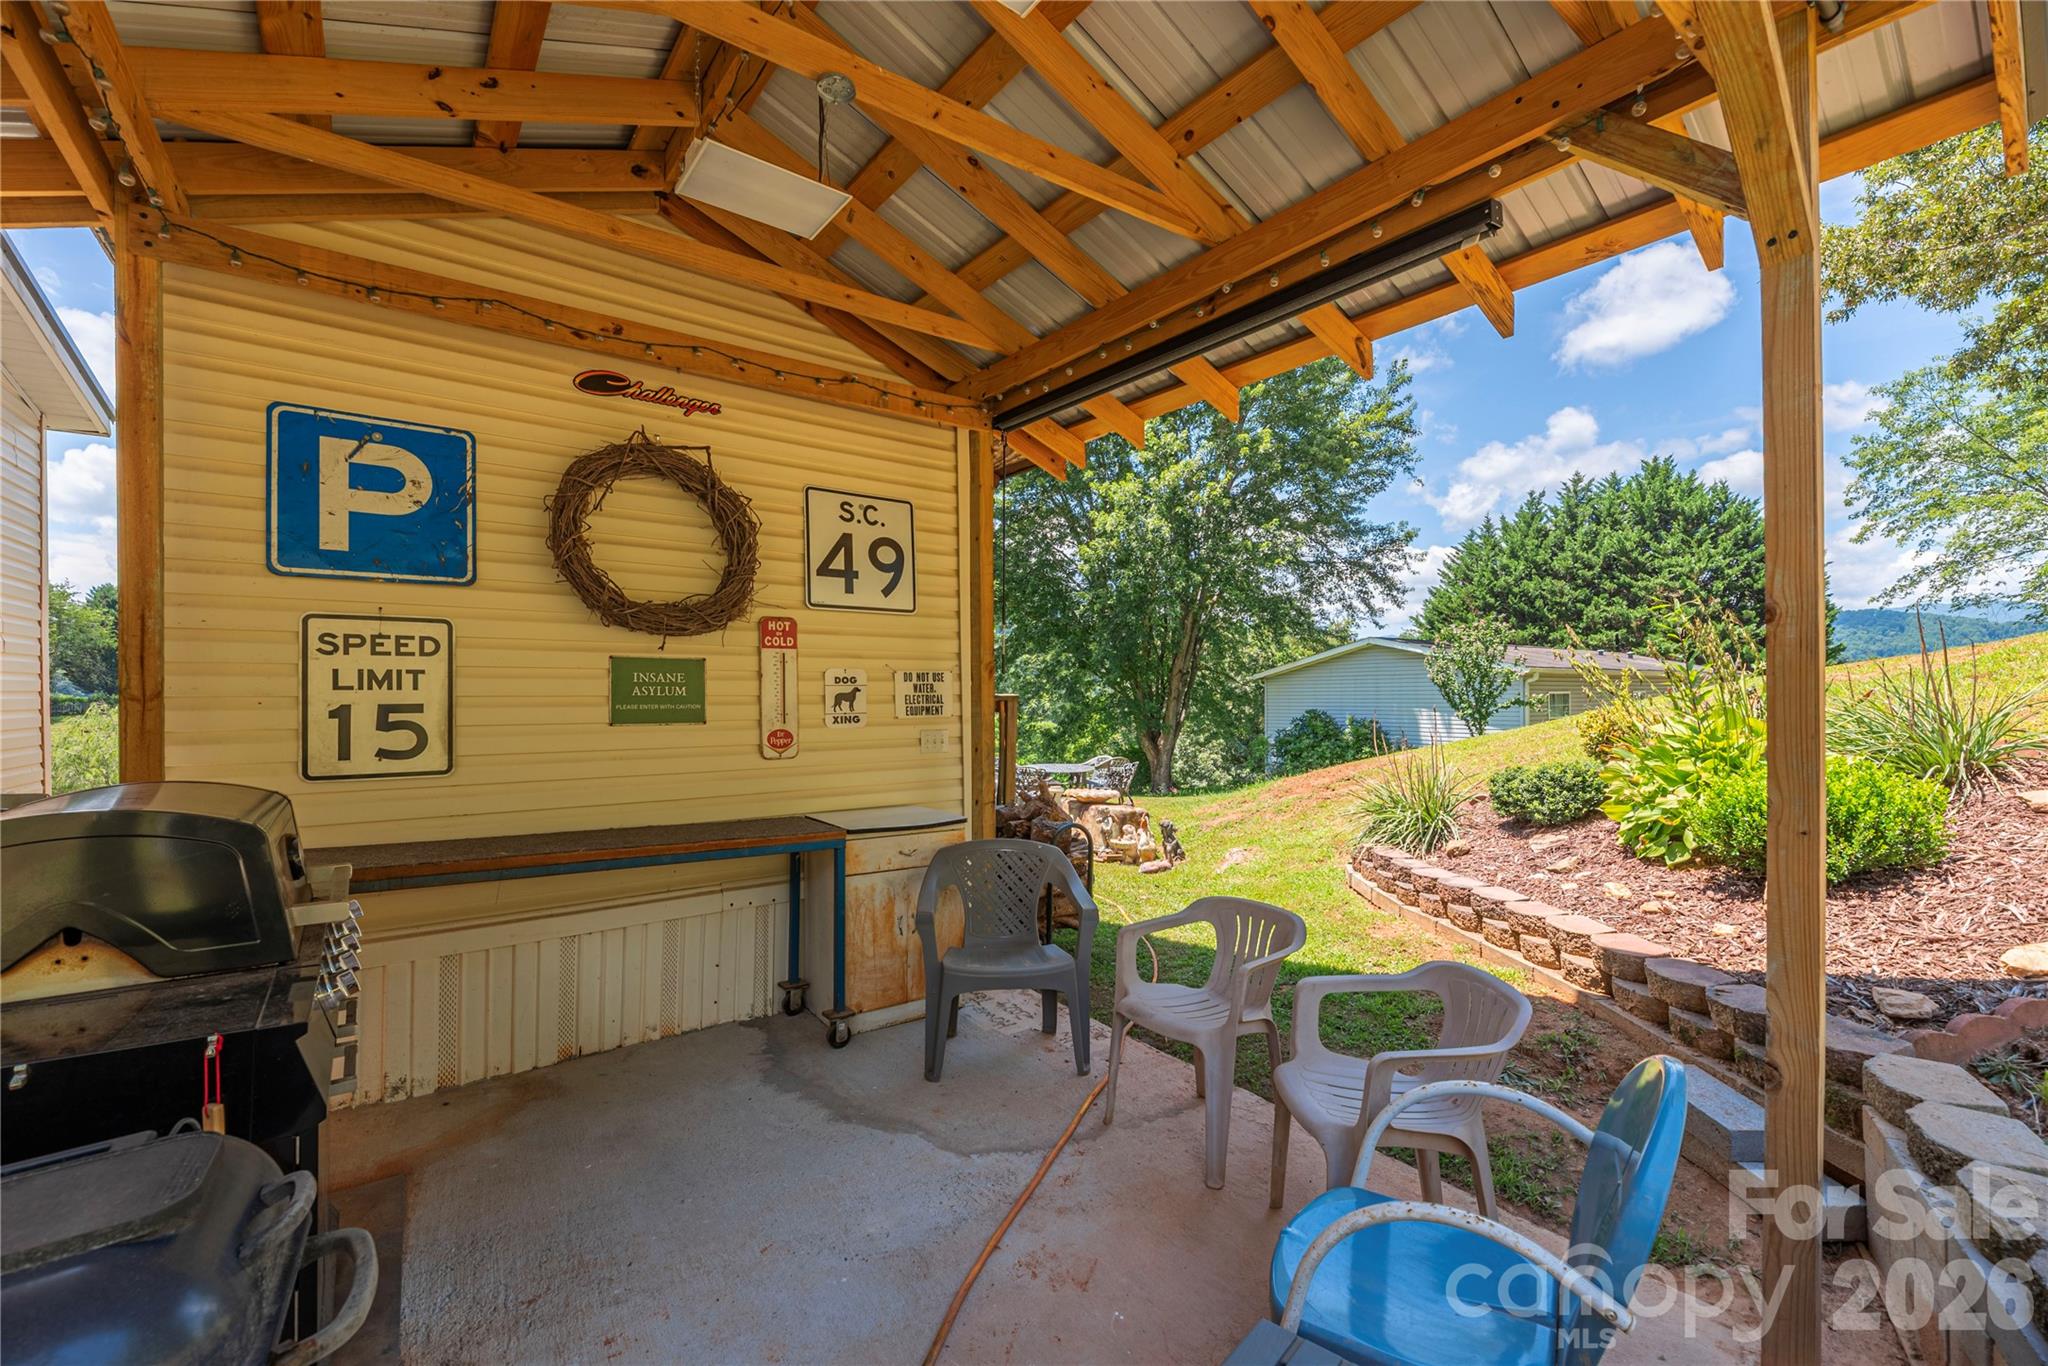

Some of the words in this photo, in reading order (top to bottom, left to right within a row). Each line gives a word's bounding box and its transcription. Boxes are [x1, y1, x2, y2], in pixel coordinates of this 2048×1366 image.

[573, 369, 721, 417] Challenger
[319, 435, 432, 552] P
[838, 501, 885, 527] S.C.
[816, 532, 905, 598] 49
[768, 621, 791, 631] HOT
[315, 632, 441, 657] SPEED
[764, 636, 794, 647] COLD
[332, 668, 426, 690] LIMIT
[632, 672, 686, 683] INSANE
[834, 676, 858, 684] DOG
[903, 672, 913, 682] DO
[916, 672, 930, 682] NOT
[932, 672, 945, 682] USE
[632, 686, 687, 696] ASYLUM
[904, 694, 944, 705] ELECTRICAL
[905, 705, 943, 716] EQUIPMENT
[832, 715, 861, 724] XING
[328, 703, 429, 761] 15
[770, 736, 792, 747] Pepper
